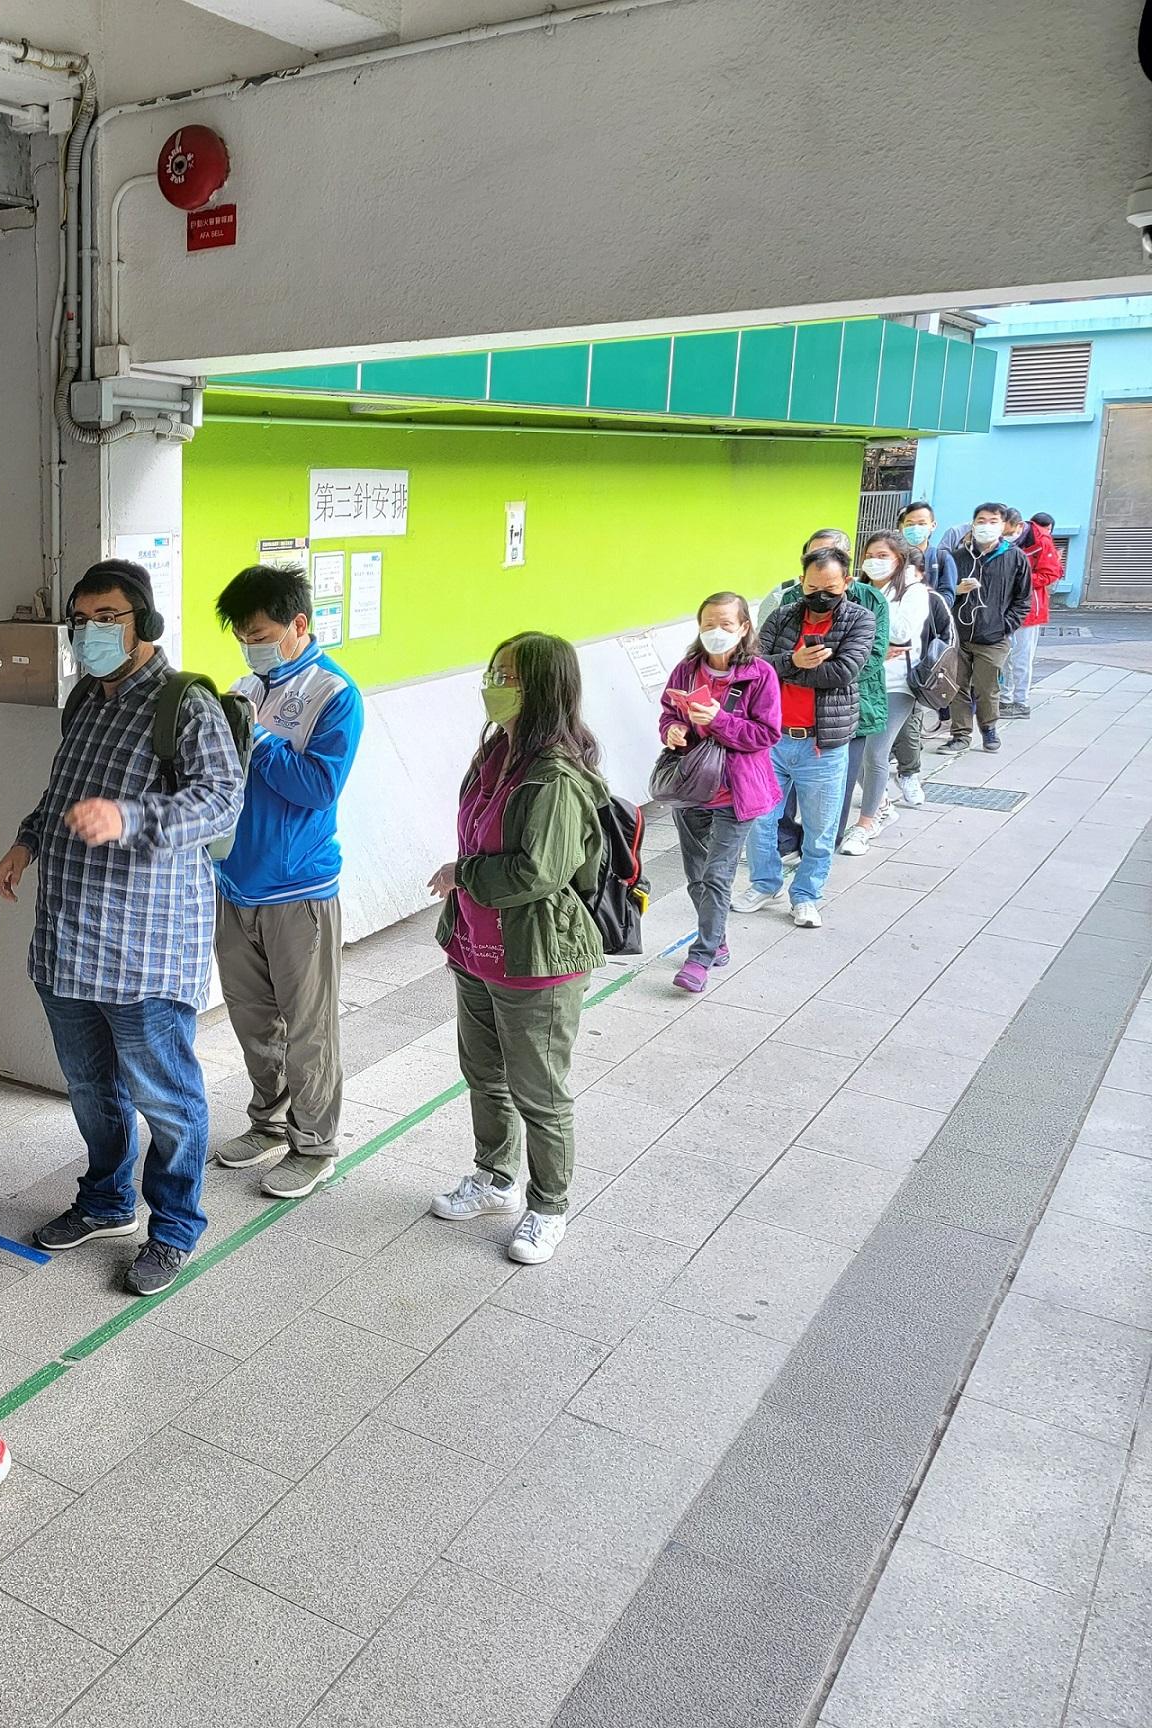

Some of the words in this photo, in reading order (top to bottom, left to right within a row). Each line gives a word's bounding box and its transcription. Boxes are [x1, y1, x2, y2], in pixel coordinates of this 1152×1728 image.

[314, 482, 407, 522] 第三針安排
[284, 690, 312, 705] ITALIA
